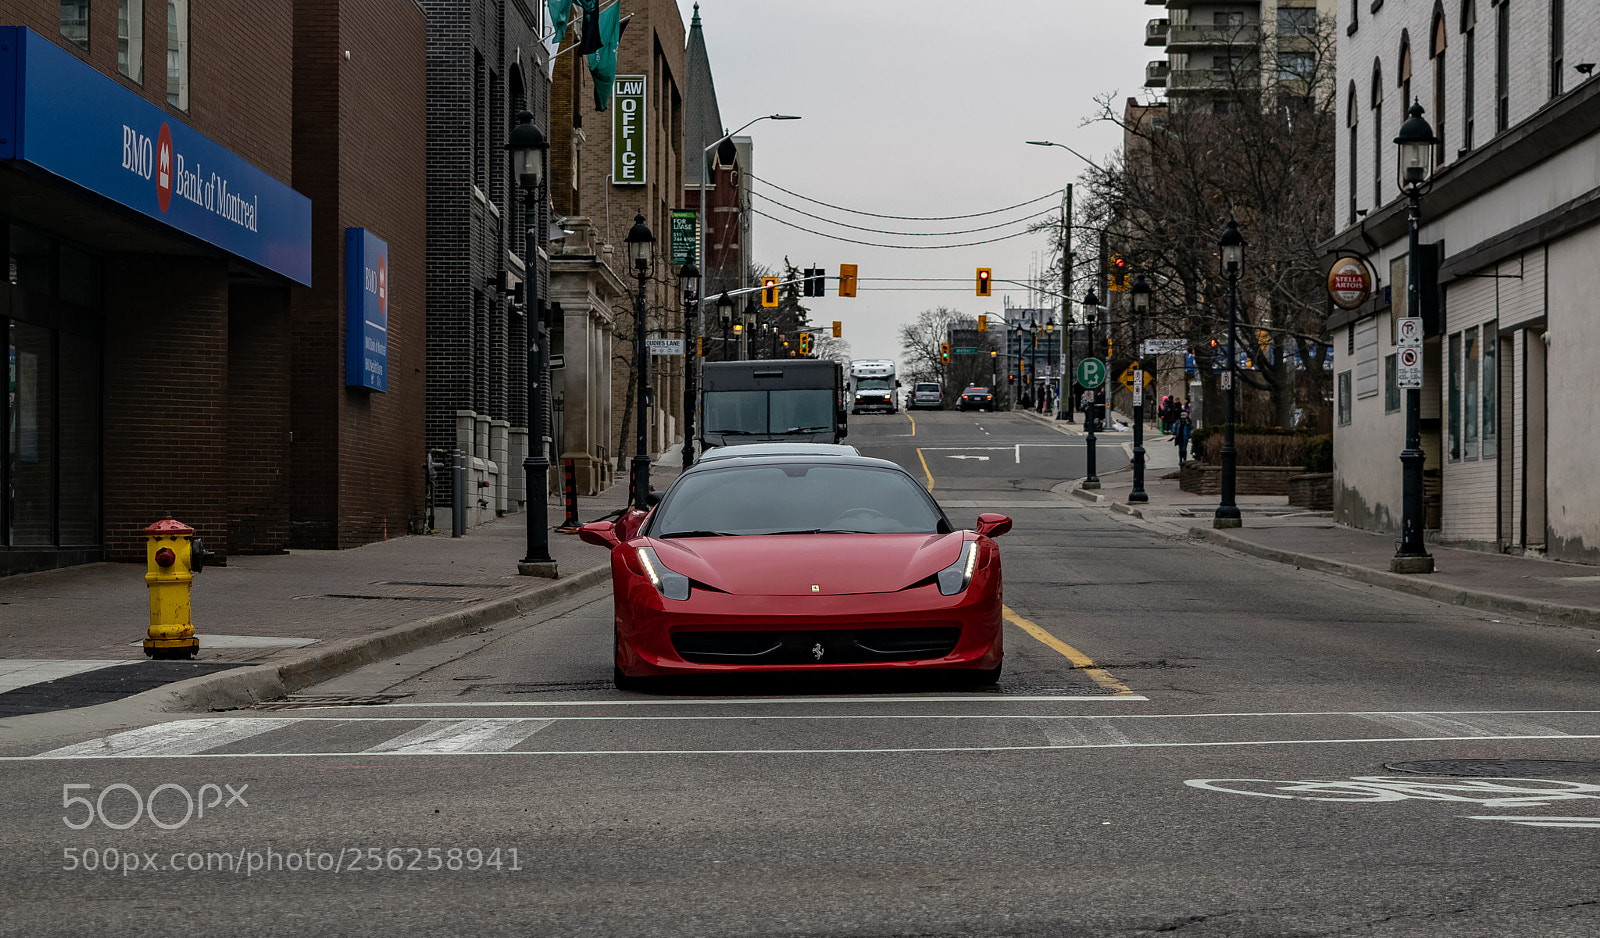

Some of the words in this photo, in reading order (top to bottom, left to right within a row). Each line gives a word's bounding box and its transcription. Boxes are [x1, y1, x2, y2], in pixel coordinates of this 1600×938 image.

[616, 81, 643, 95] LAW
[122, 124, 153, 180] BMO
[176, 153, 204, 206] Bank
[204, 172, 216, 211] of
[217, 176, 257, 232] Montreal
[621, 98, 637, 179] OFFICE
